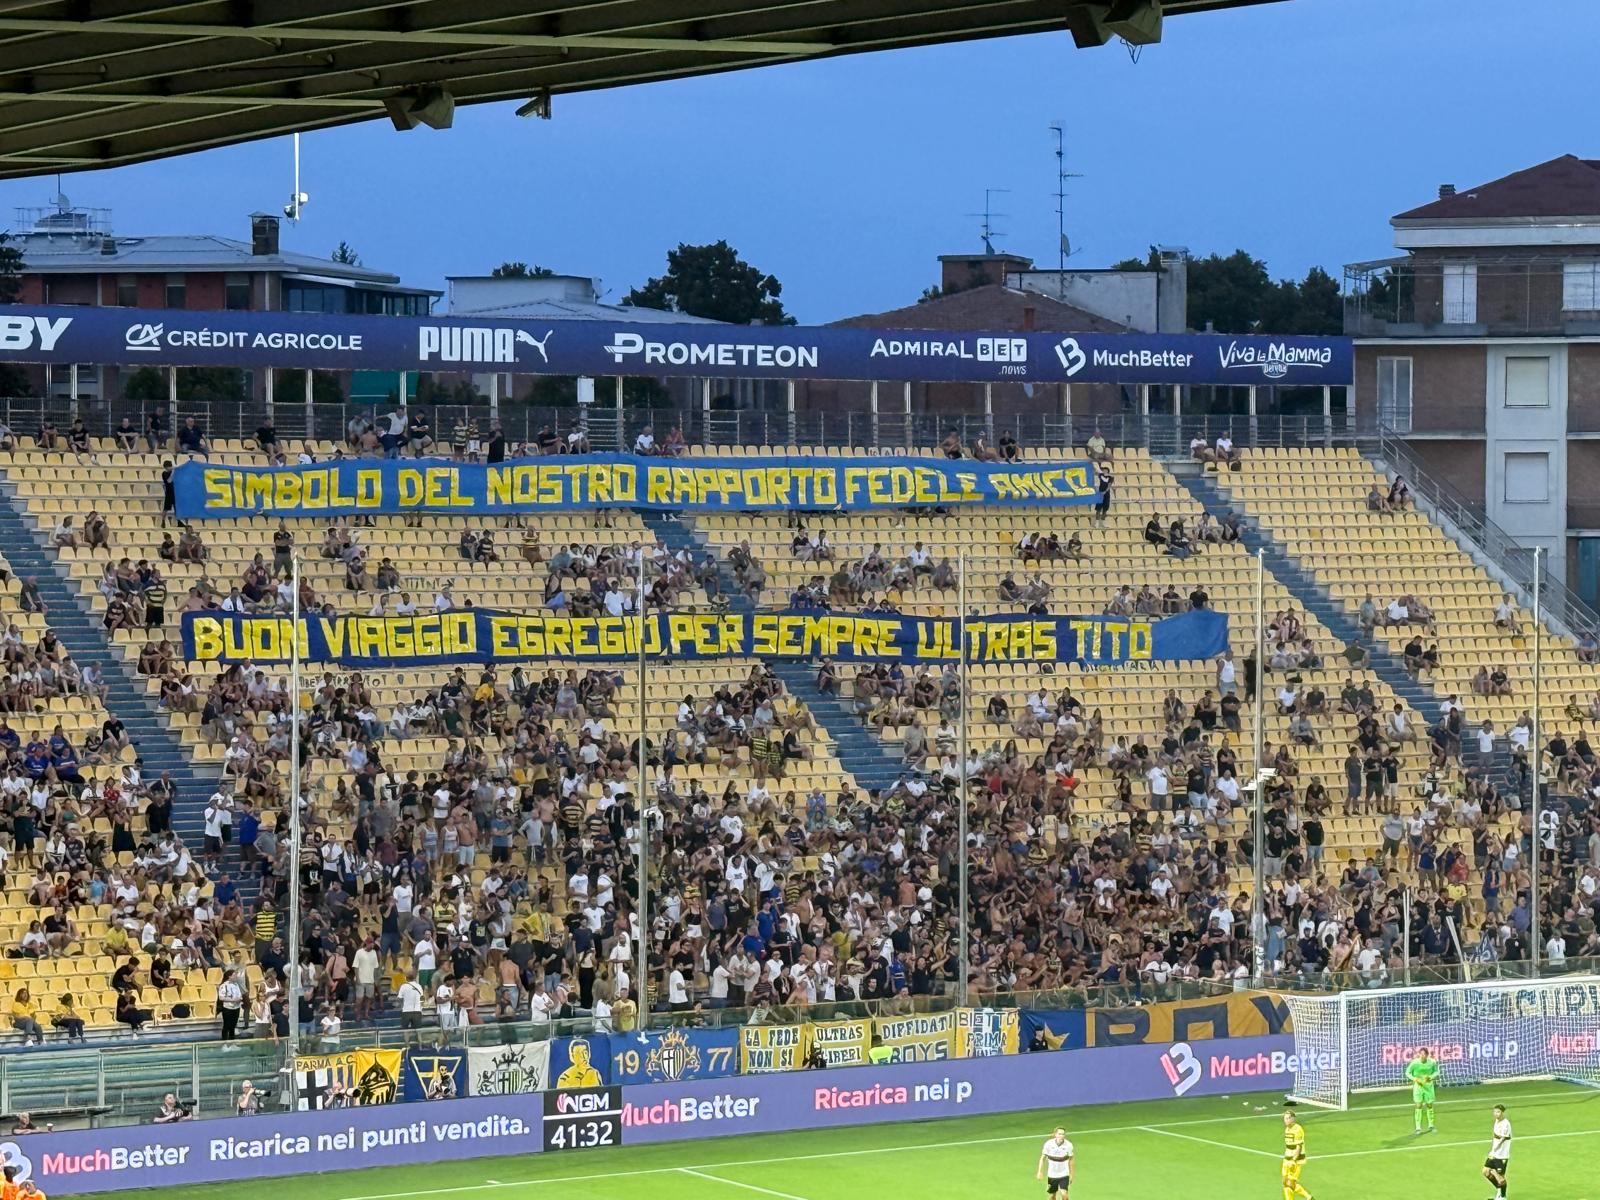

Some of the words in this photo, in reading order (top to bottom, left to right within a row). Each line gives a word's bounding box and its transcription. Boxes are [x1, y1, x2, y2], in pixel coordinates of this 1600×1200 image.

[167, 328, 248, 348] CRÉDIT
[252, 332, 363, 351] AGRICOLE
[419, 326, 515, 363] PUMA
[603, 332, 818, 368] PROMETEON
[870, 338, 974, 359] ADMIRAL
[978, 340, 1026, 359] BET
[1093, 349, 1193, 367] MuchBetter
[1219, 340, 1255, 368] Viva
[203, 467, 382, 510] SIMBOLO
[398, 466, 475, 507] DEL
[486, 463, 637, 506] NOSTRO
[647, 466, 837, 506] RAPPORTO
[844, 466, 985, 504] FEDELE
[193, 616, 310, 660] BUON
[319, 612, 478, 658] VIAGGIO
[668, 614, 744, 654] PER
[753, 614, 902, 657] SEMPRE
[917, 620, 1057, 661] ULTRAS
[1071, 620, 1153, 661] TITO
[768, 1027, 800, 1046] FEDE
[816, 1026, 863, 1042] ULTRAS
[883, 1013, 953, 1040] DIFFIDATI
[966, 1031, 1007, 1048] PRIMA
[707, 1047, 733, 1072] 77
[748, 1049, 773, 1067] NON
[780, 1048, 793, 1066] SI
[1470, 1036, 1498, 1059] nei
[296, 1057, 331, 1072] PARMA
[614, 1050, 640, 1076] 19
[1210, 1050, 1341, 1079] MuchBetter
[564, 1092, 609, 1113] NGM
[815, 1083, 908, 1110] Ricarica
[915, 1078, 949, 1102] nei
[957, 1081, 973, 1103] p
[210, 1133, 310, 1161] Ricarica
[317, 1127, 355, 1151] nei
[362, 1121, 426, 1151] punti
[433, 1115, 531, 1140] vendita.
[550, 1121, 613, 1149] 41:32
[43, 1144, 189, 1176] MuchBetter
